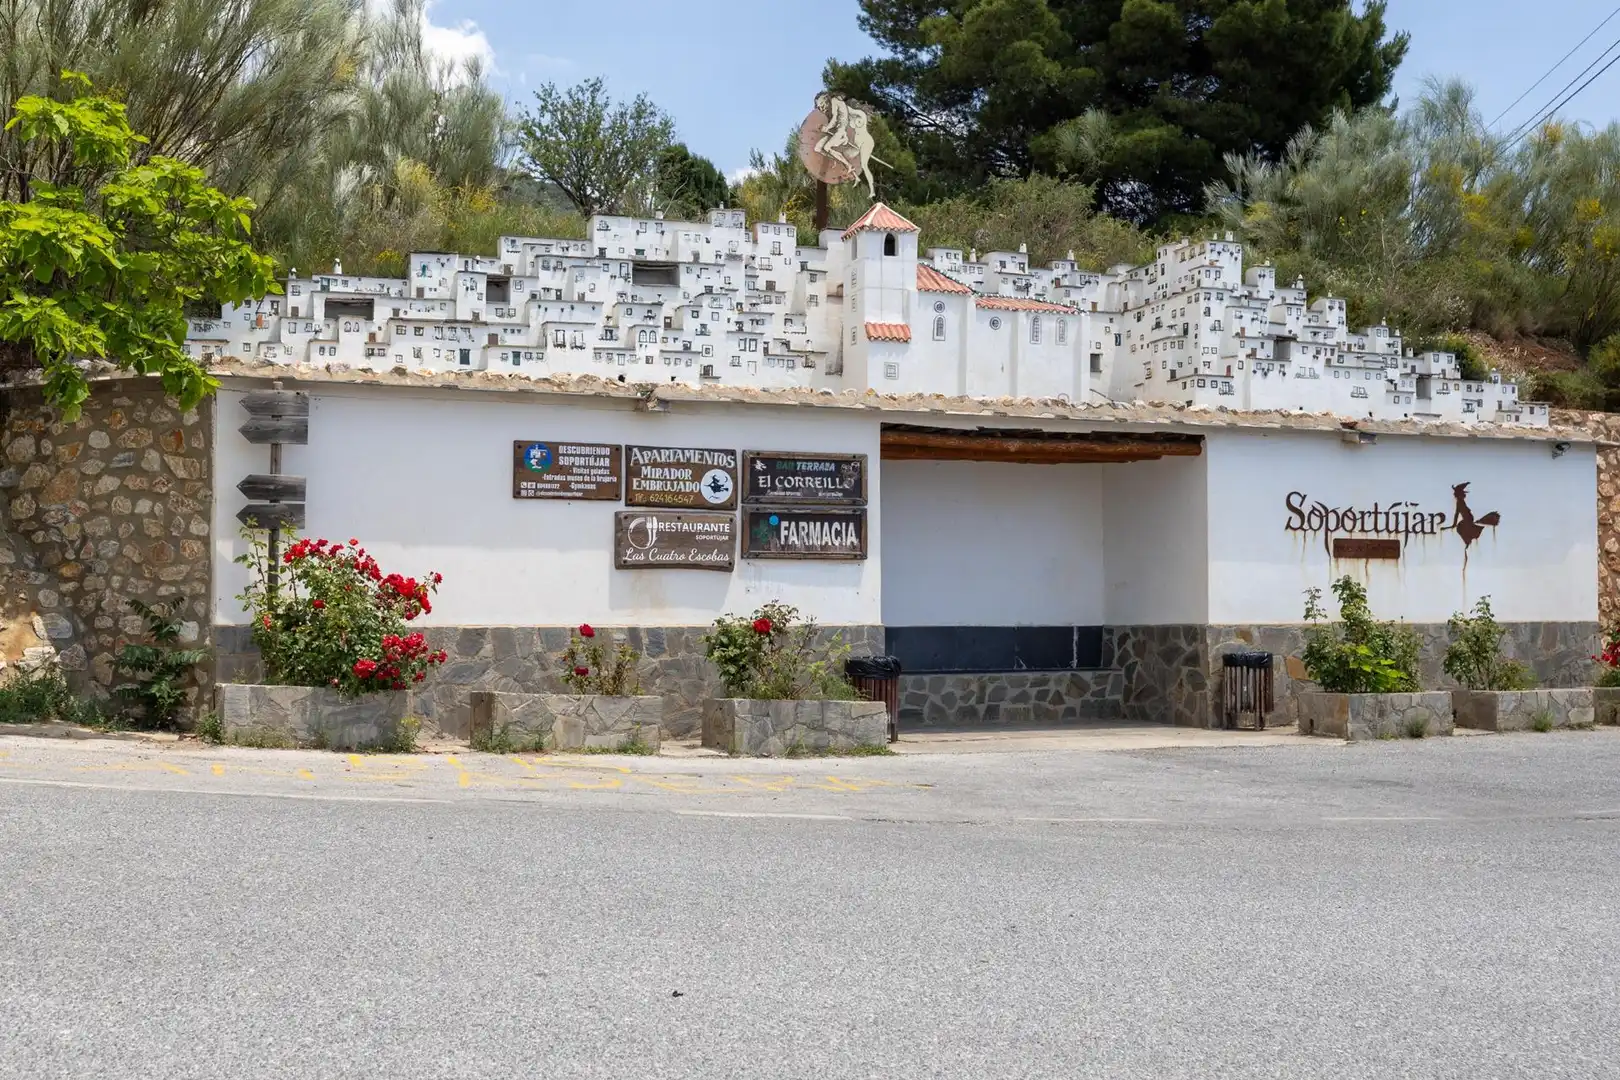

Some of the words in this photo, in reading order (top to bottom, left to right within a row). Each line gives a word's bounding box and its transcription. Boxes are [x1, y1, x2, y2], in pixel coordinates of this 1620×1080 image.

[558, 446, 610, 455] DESCUBRIENDO
[558, 456, 610, 466] SOPORTÚJAR
[630, 448, 735, 468] APARTAMENTOS
[641, 466, 692, 480] MIRADOR
[796, 462, 836, 472] TERRAZA
[632, 478, 700, 492] EMBRUJADO
[776, 476, 854, 488] CORREILLO
[650, 493, 694, 504] 624164547
[658, 522, 730, 532] RESTAURANTE
[780, 521, 858, 546] FARMACIA
[622, 547, 644, 562] Las
[648, 548, 686, 562] Cuatro
[688, 548, 730, 562] Escobas
